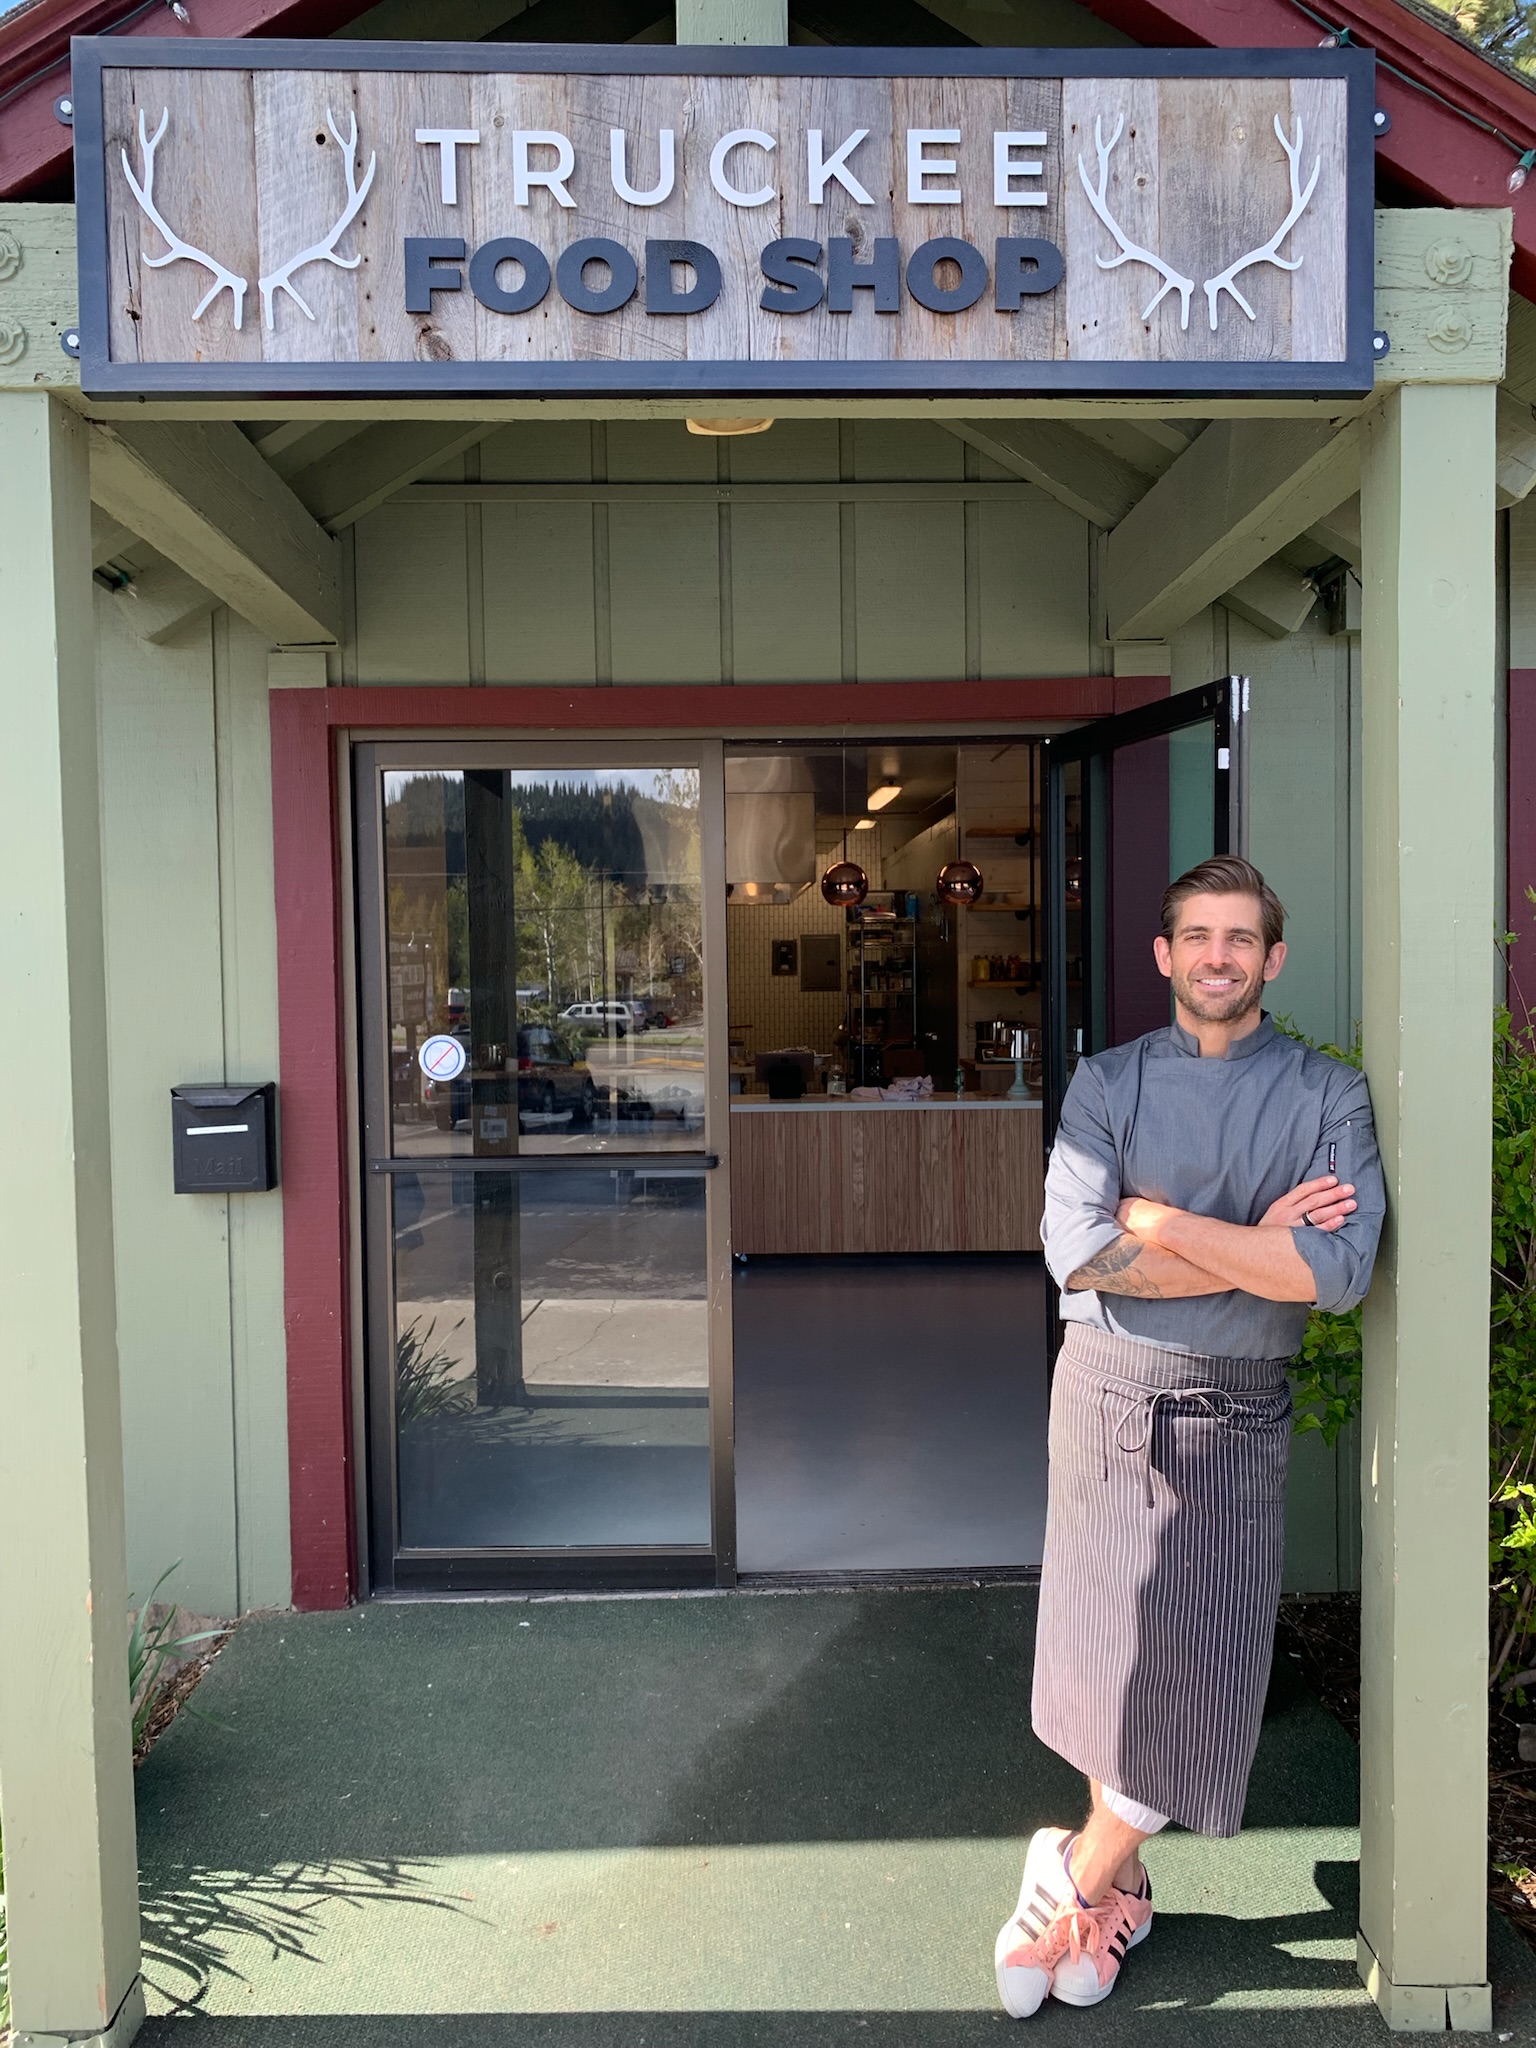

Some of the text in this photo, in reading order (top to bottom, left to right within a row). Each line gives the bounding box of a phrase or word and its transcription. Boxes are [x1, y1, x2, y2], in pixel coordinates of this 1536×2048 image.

[415, 128, 1049, 207] TRUCKEE
[404, 237, 1065, 316] FOOD SHOP
[194, 1157, 243, 1176] Mail
